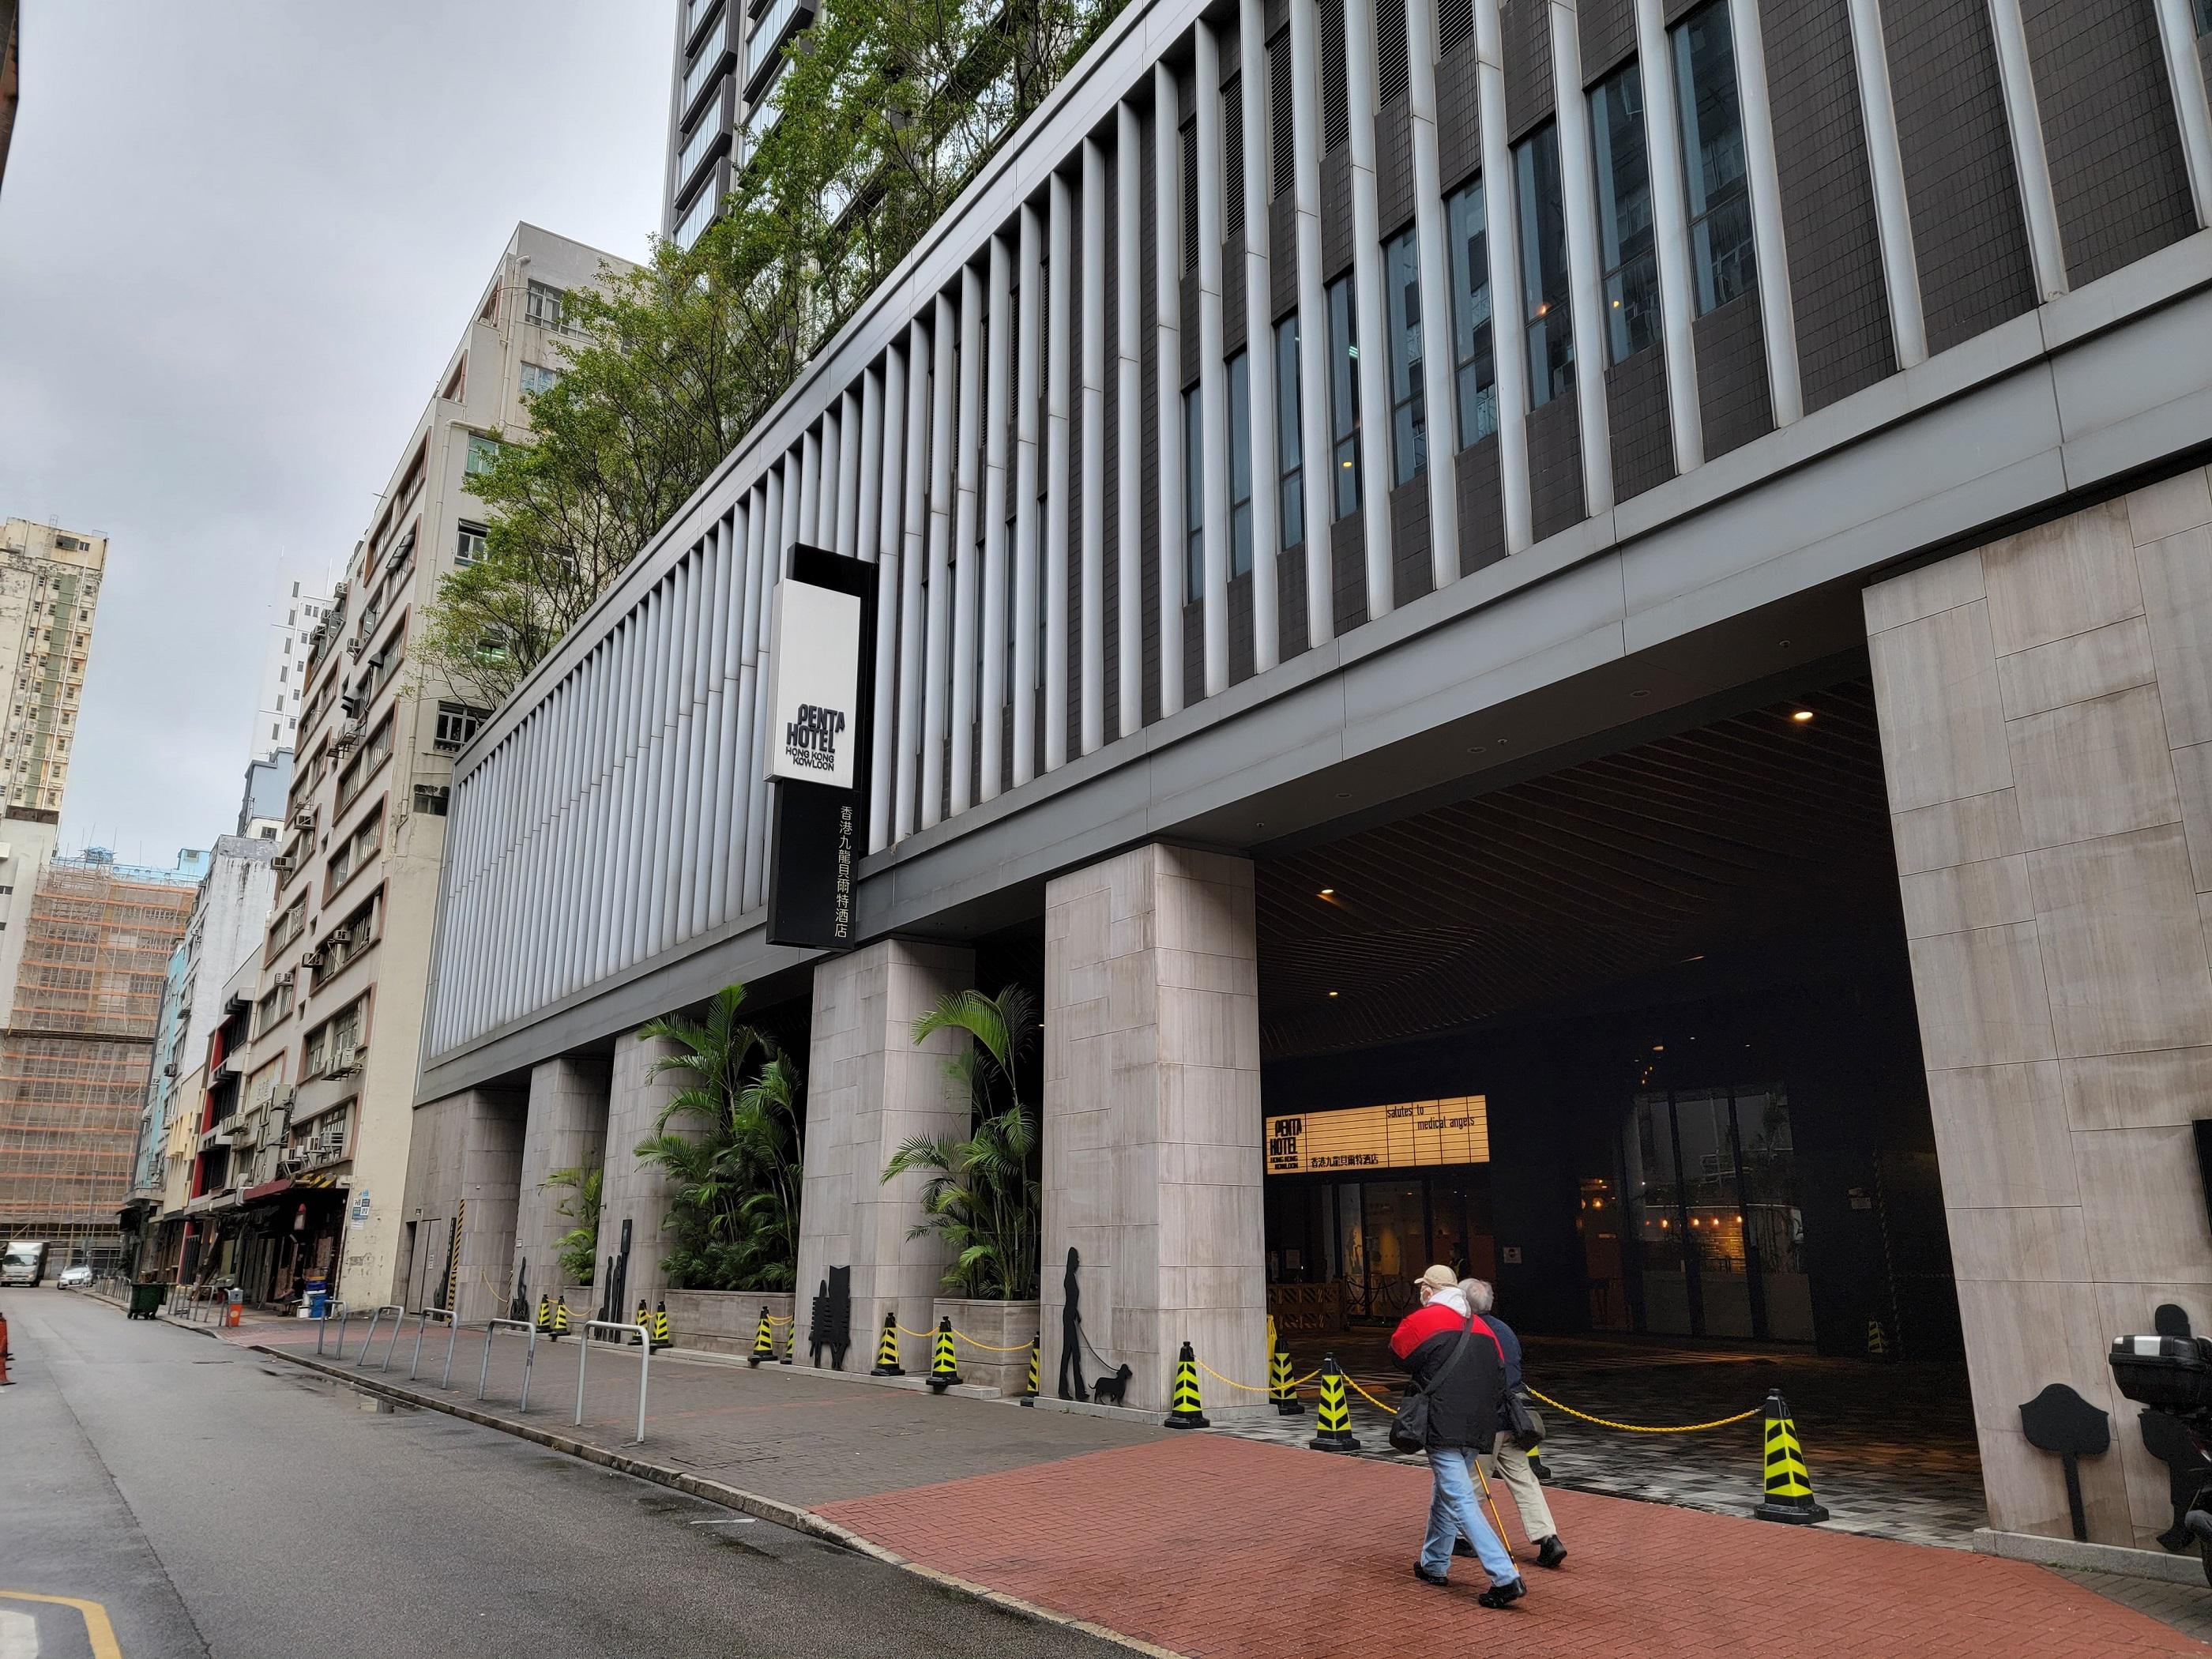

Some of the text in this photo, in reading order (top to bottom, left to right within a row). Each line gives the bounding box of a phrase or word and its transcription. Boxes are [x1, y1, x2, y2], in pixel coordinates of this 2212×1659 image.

[798, 704, 845, 733] PENTA
[787, 722, 835, 753] HOTEL
[785, 747, 834, 762] HONG KONG
[793, 756, 834, 771] KOWLOON
[835, 806, 853, 938] 香港九龍貝爾特酒店
[1387, 1104, 1424, 1118] salutes to
[1275, 1118, 1302, 1138] PENTA
[1418, 1114, 1475, 1130] medical angels
[1270, 1137, 1297, 1156] HOTEL
